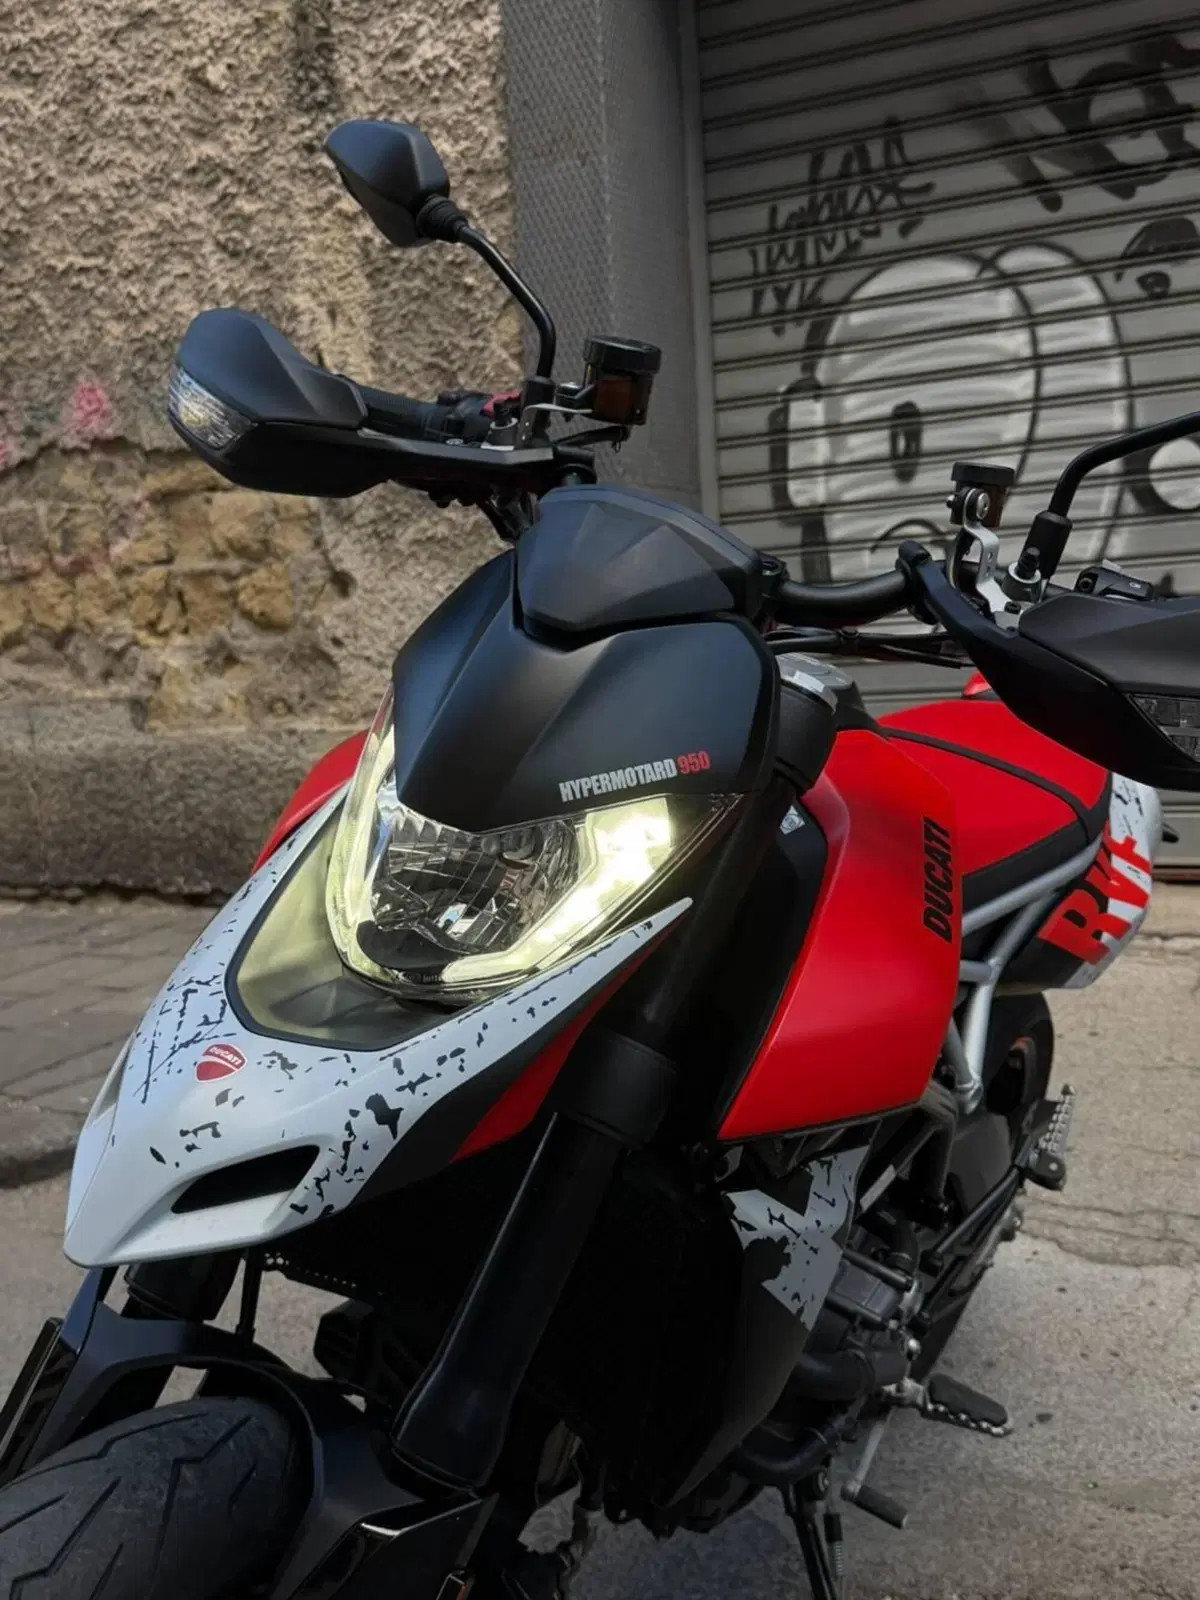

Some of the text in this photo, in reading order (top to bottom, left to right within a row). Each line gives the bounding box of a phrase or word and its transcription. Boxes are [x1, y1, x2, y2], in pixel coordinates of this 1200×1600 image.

[558, 750, 711, 803] HYPERMOTARD 950
[922, 816, 952, 943] DUCATI
